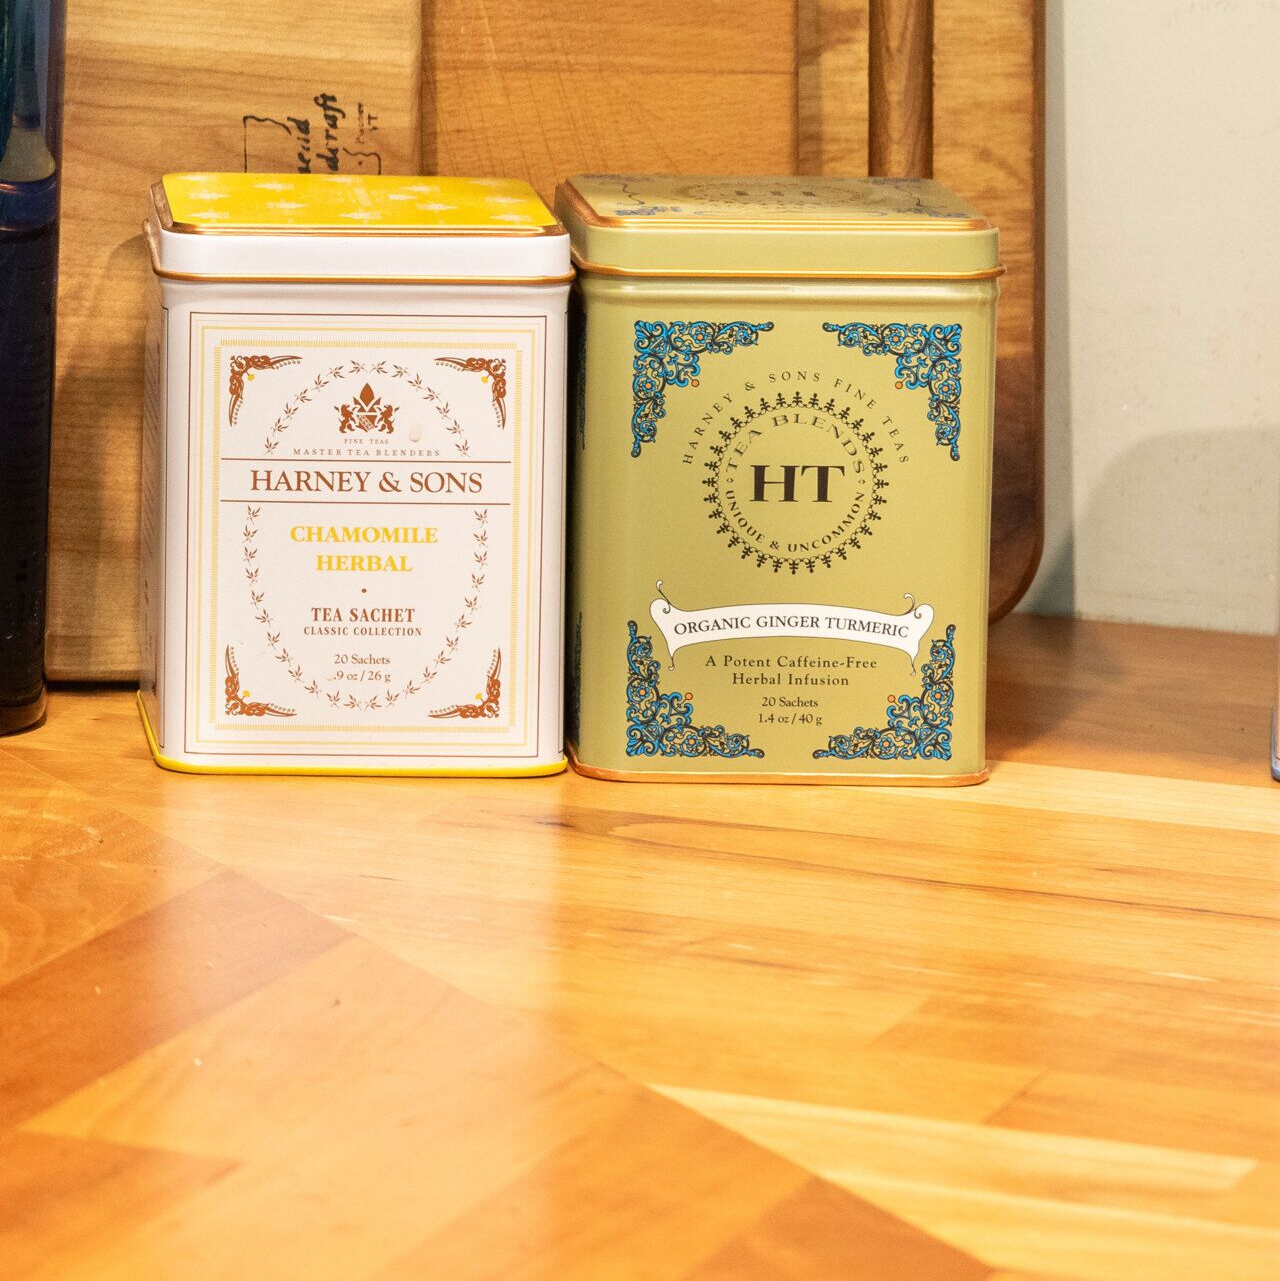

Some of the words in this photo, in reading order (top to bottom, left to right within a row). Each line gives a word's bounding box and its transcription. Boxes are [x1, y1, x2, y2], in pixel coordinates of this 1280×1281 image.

[682, 393, 735, 465] HARNEY
[744, 381, 756, 392] &
[768, 370, 821, 383] SONS
[833, 377, 877, 410] FINE
[881, 415, 909, 464] TEAS
[726, 428, 763, 473] TEA
[770, 412, 865, 474] BLENDS
[293, 448, 342, 456] MASTER
[348, 448, 370, 456] TEA
[376, 449, 440, 457] BLENDERS
[250, 470, 372, 493] HARNEY
[378, 471, 402, 493] &
[409, 471, 483, 494] SONS
[749, 464, 846, 503] HT
[725, 490, 766, 543] UNIQUE
[769, 540, 780, 551] &
[787, 492, 865, 553] UNCOMMON
[290, 526, 439, 544] CHAMOMILE
[316, 555, 413, 572] HERBAL
[311, 607, 343, 622] TEA
[349, 607, 416, 623] SACHET
[304, 626, 349, 636] CLASSIC
[353, 627, 422, 636] COLLECTION
[673, 616, 751, 636] ORGANIC
[756, 615, 820, 629] GINGER
[825, 617, 909, 638] TURMERIC
[334, 654, 348, 665] 20
[351, 654, 391, 665] Sachets
[705, 657, 717, 668] A
[723, 655, 771, 668] Potent
[777, 655, 877, 669] Caffeine-Free
[333, 670, 344, 681] .9
[347, 673, 358, 681] oz
[360, 670, 366, 681] /
[367, 670, 382, 681] 26
[385, 673, 391, 683] g
[732, 672, 781, 686] Herbal
[788, 673, 849, 687] Infusion
[761, 697, 776, 707] 20
[779, 696, 819, 708] Sachets
[758, 714, 775, 724] 1.4
[778, 716, 789, 724] oz
[791, 713, 797, 725] /
[799, 714, 814, 724] 40
[815, 716, 823, 726] g
